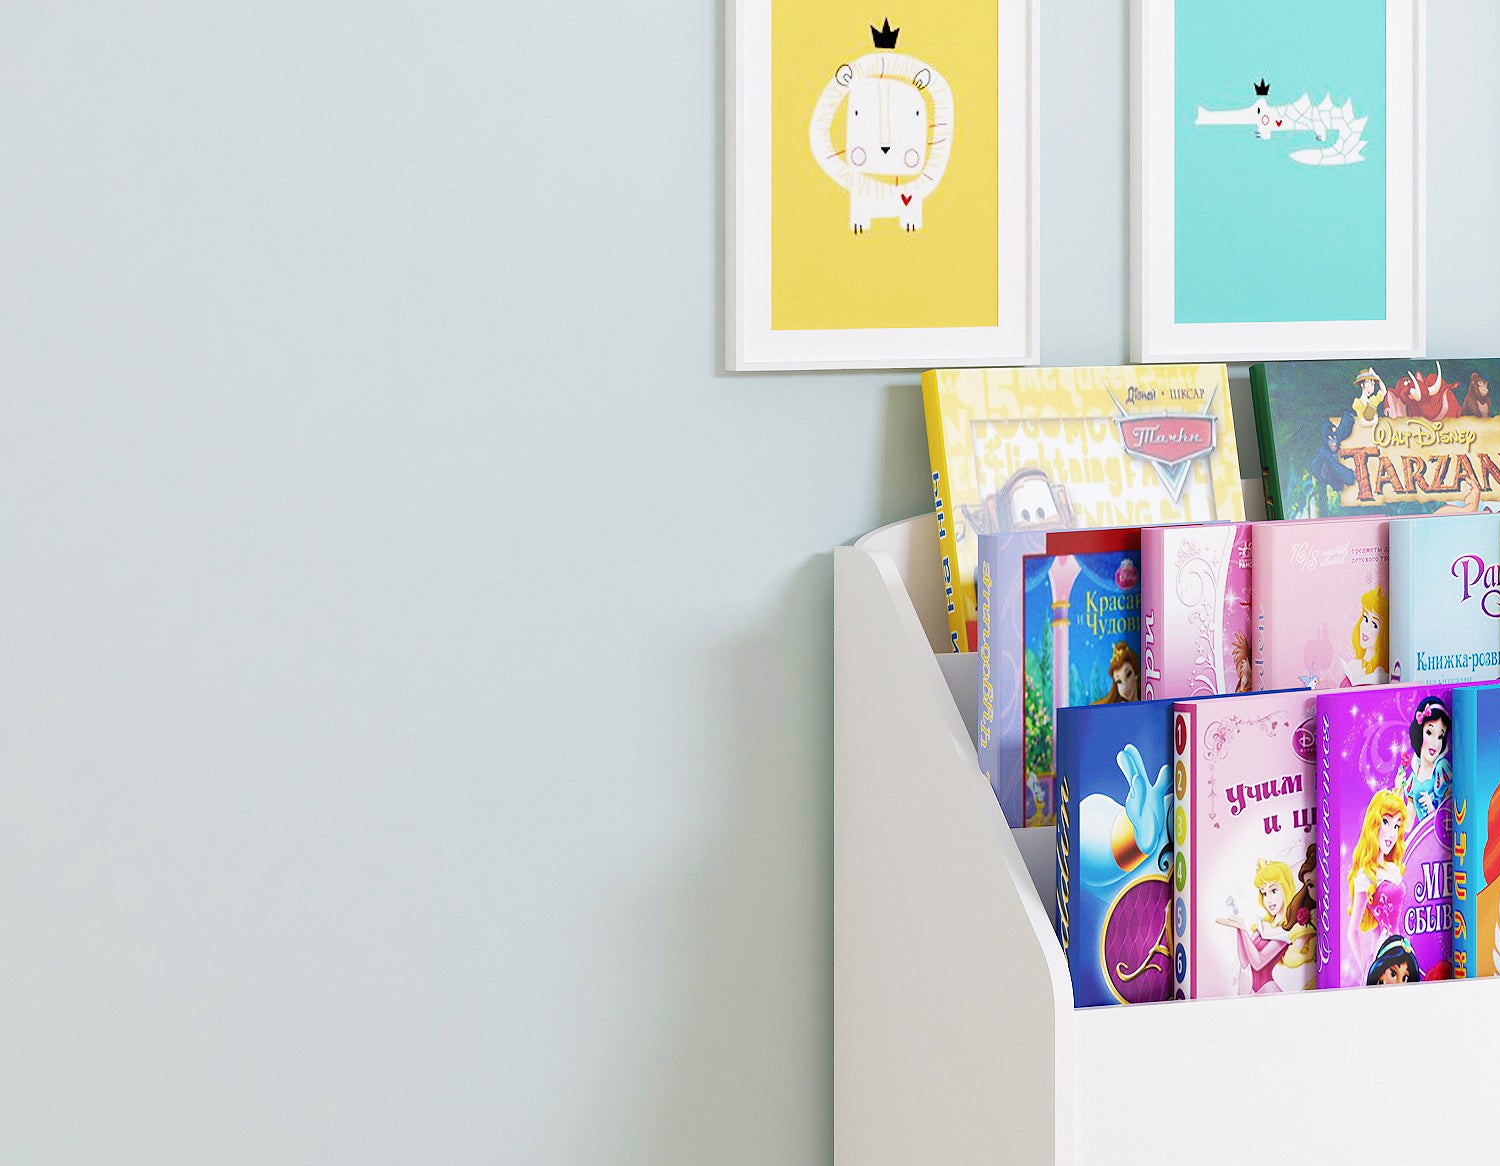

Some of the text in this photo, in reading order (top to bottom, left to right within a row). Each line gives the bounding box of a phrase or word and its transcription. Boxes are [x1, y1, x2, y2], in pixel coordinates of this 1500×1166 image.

[1133, 424, 1203, 447] Тачки
[1177, 727, 1183, 746] 1
[1177, 772, 1183, 791] 2
[1226, 773, 1303, 816] Учим
[1177, 818, 1183, 837] 3
[1264, 815, 1282, 834] и
[1177, 864, 1183, 883] 4
[1177, 909, 1183, 928] 5
[1177, 954, 1183, 975] 6
